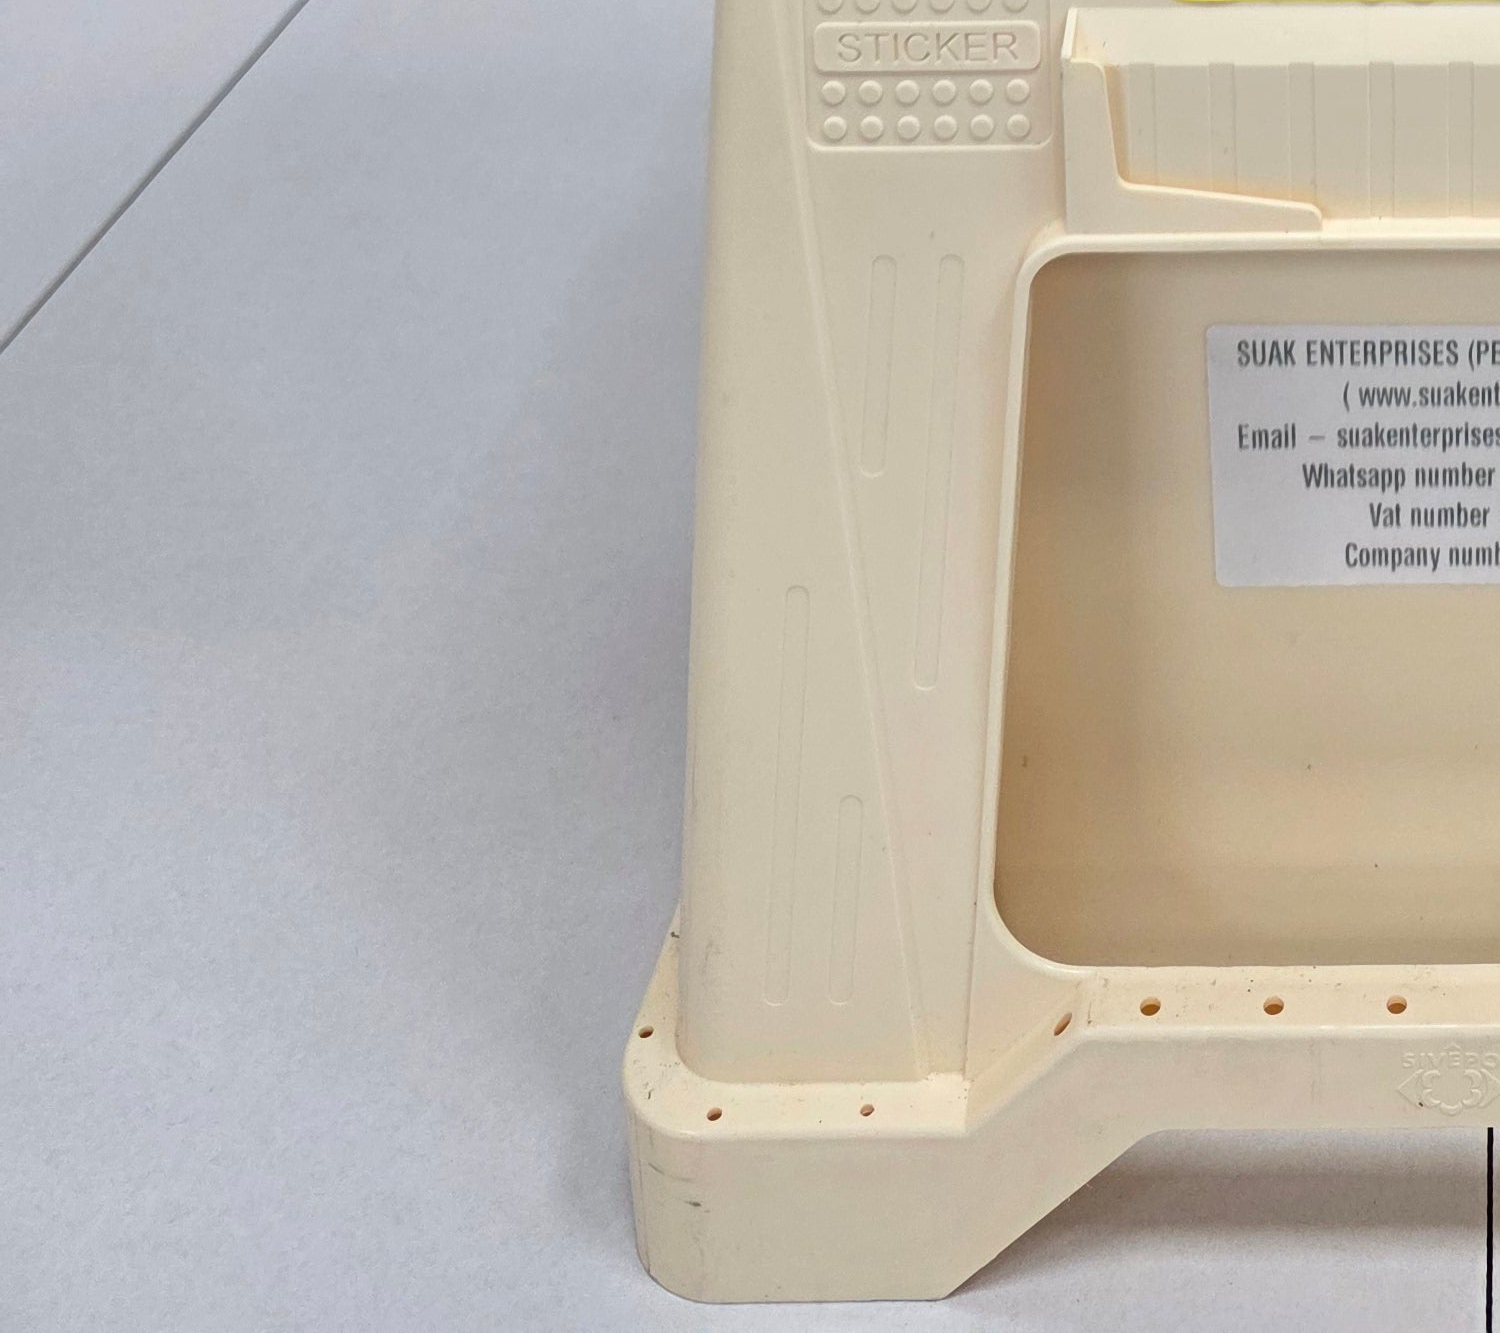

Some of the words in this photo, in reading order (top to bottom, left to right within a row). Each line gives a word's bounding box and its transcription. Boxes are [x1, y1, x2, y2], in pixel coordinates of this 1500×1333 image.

[837, 32, 1020, 63] STICKER
[1237, 340, 1296, 367] SUAK
[1306, 339, 1459, 366] ENTERPRISES
[1238, 423, 1296, 450] Email
[1302, 462, 1406, 494] Whatsapp
[1415, 461, 1496, 487] number
[1369, 502, 1401, 528] Vat
[1410, 501, 1490, 528] number
[1345, 542, 1441, 572] Company
